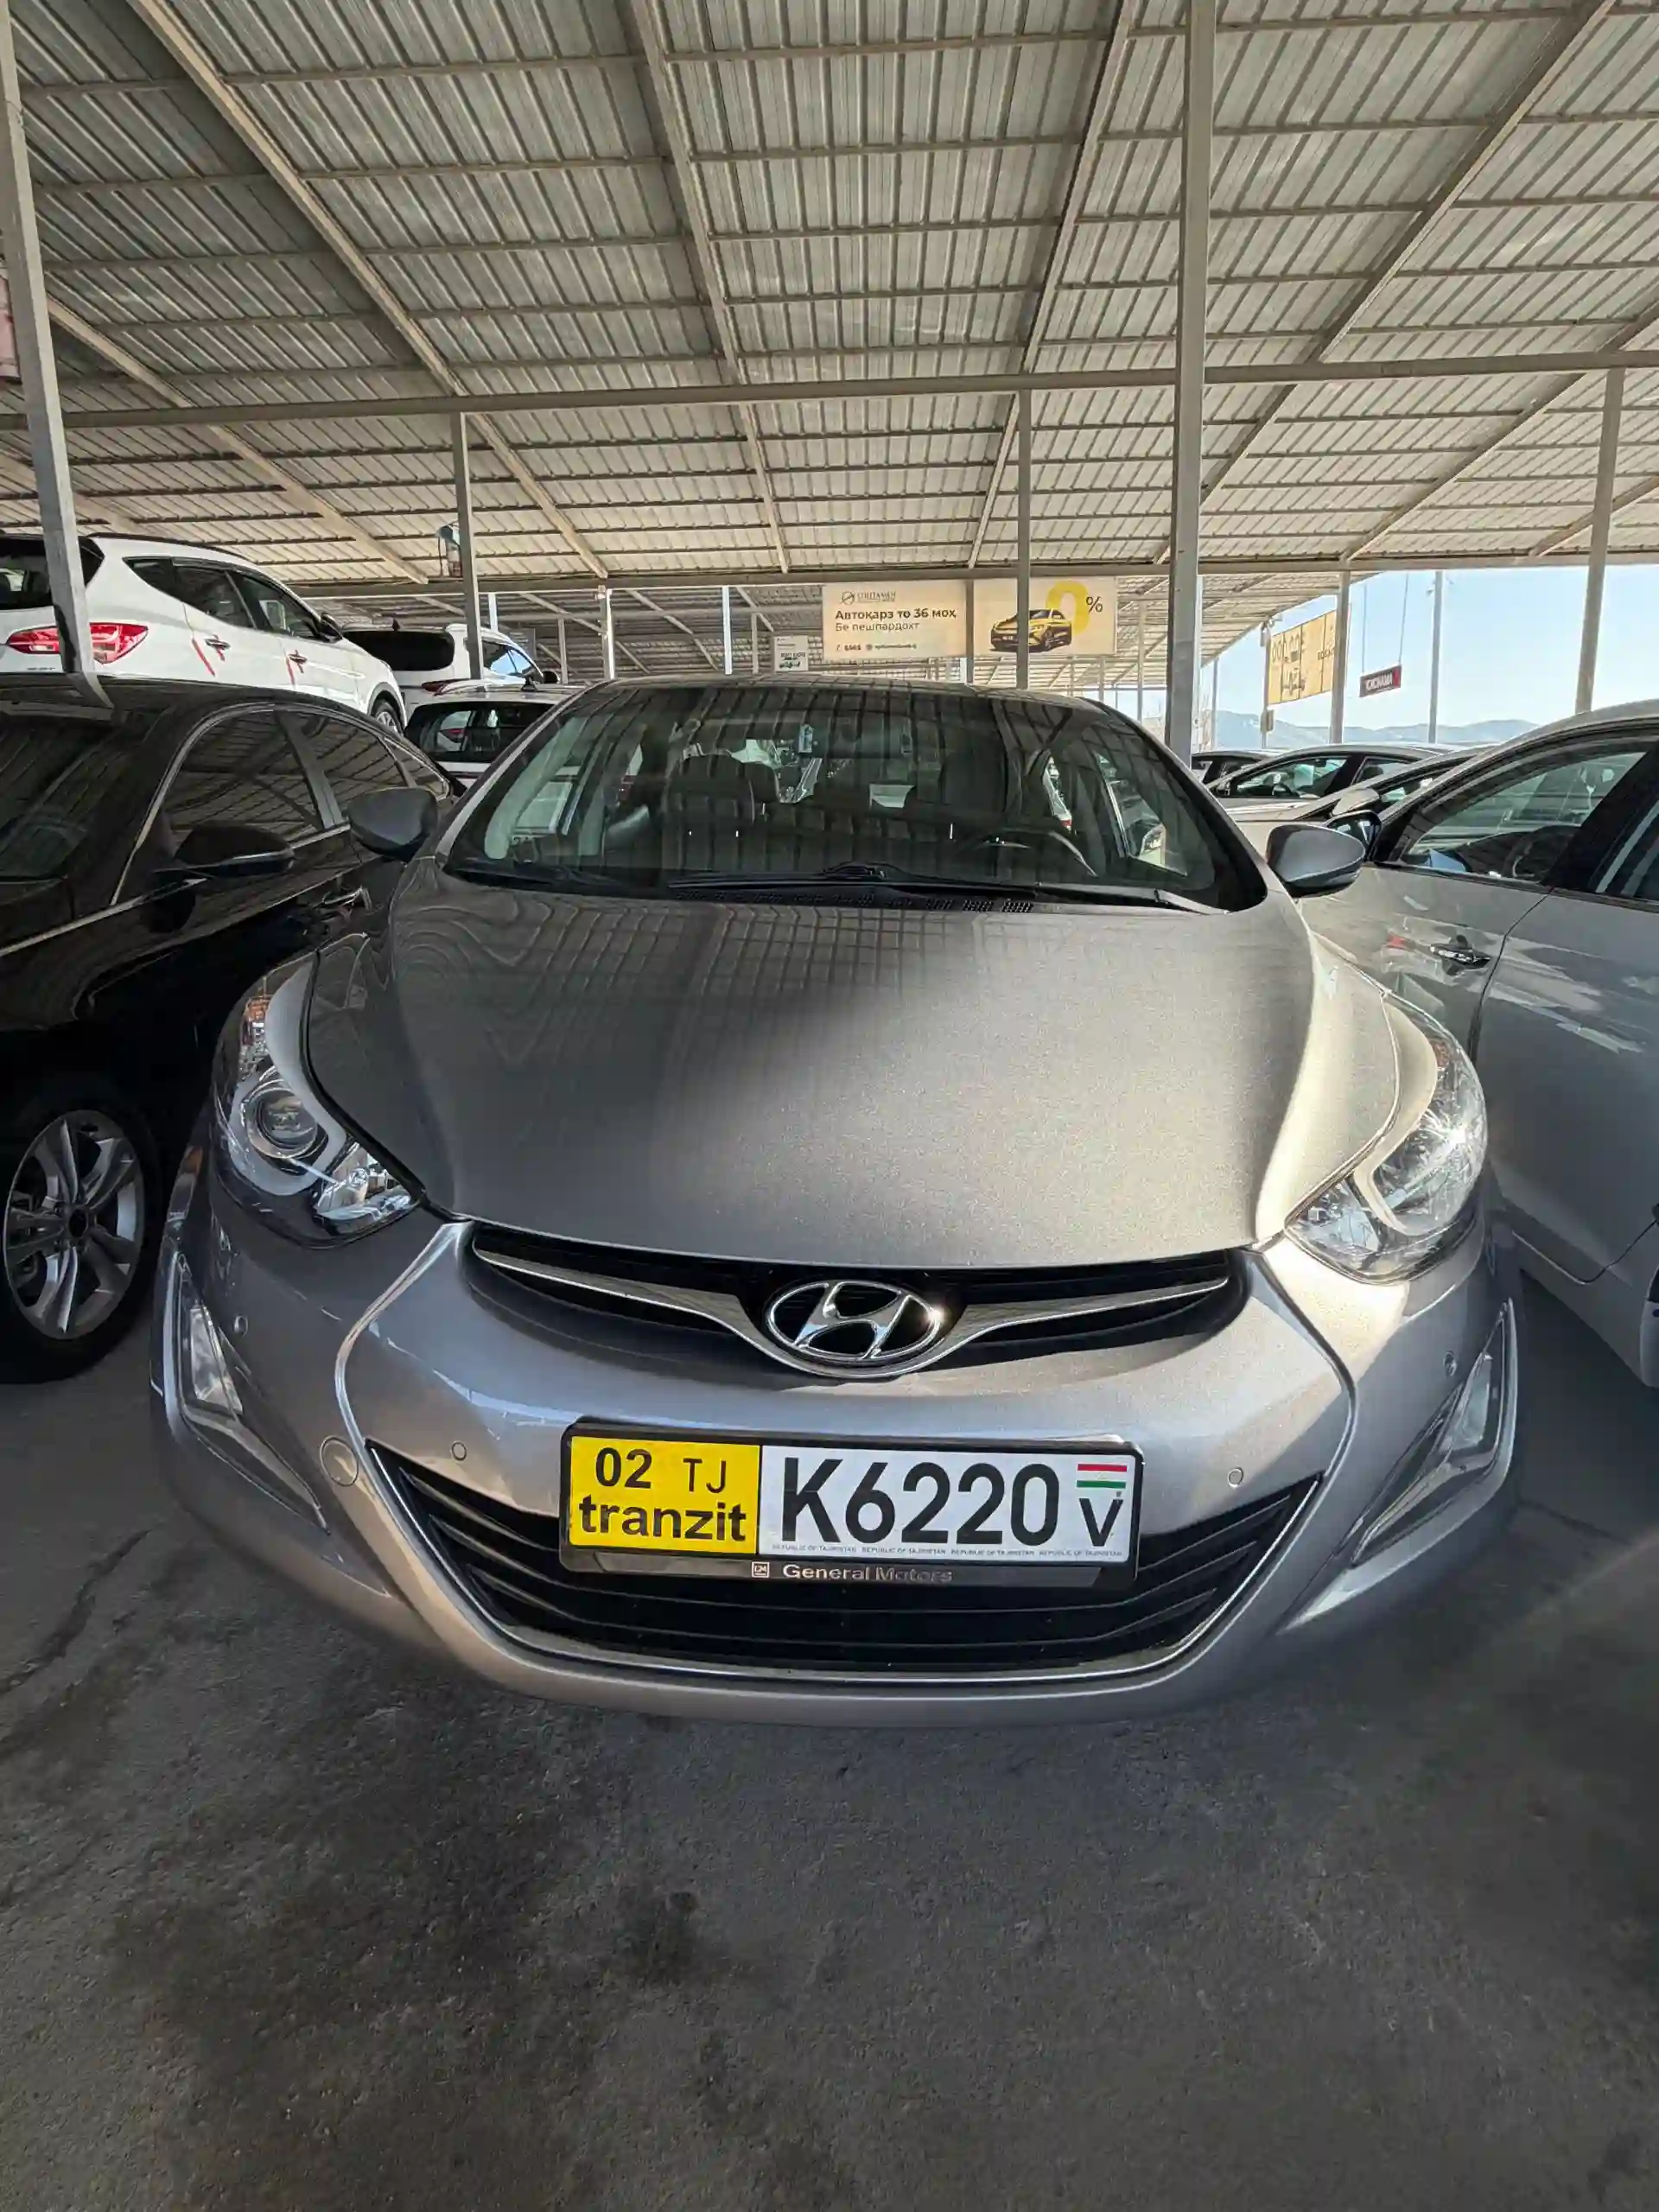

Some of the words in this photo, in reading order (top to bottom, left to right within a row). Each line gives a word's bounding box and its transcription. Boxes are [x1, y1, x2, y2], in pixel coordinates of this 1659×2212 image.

[836, 622, 849, 632] Бе
[913, 608, 929, 619] 36
[595, 1446, 652, 1490] 02
[682, 1457, 727, 1494] TJ
[578, 1494, 747, 1542] tranzit
[781, 1456, 1060, 1547] K6220
[1078, 1497, 1124, 1548] V
[782, 1564, 870, 1581] General
[875, 1567, 952, 1582] Motors
